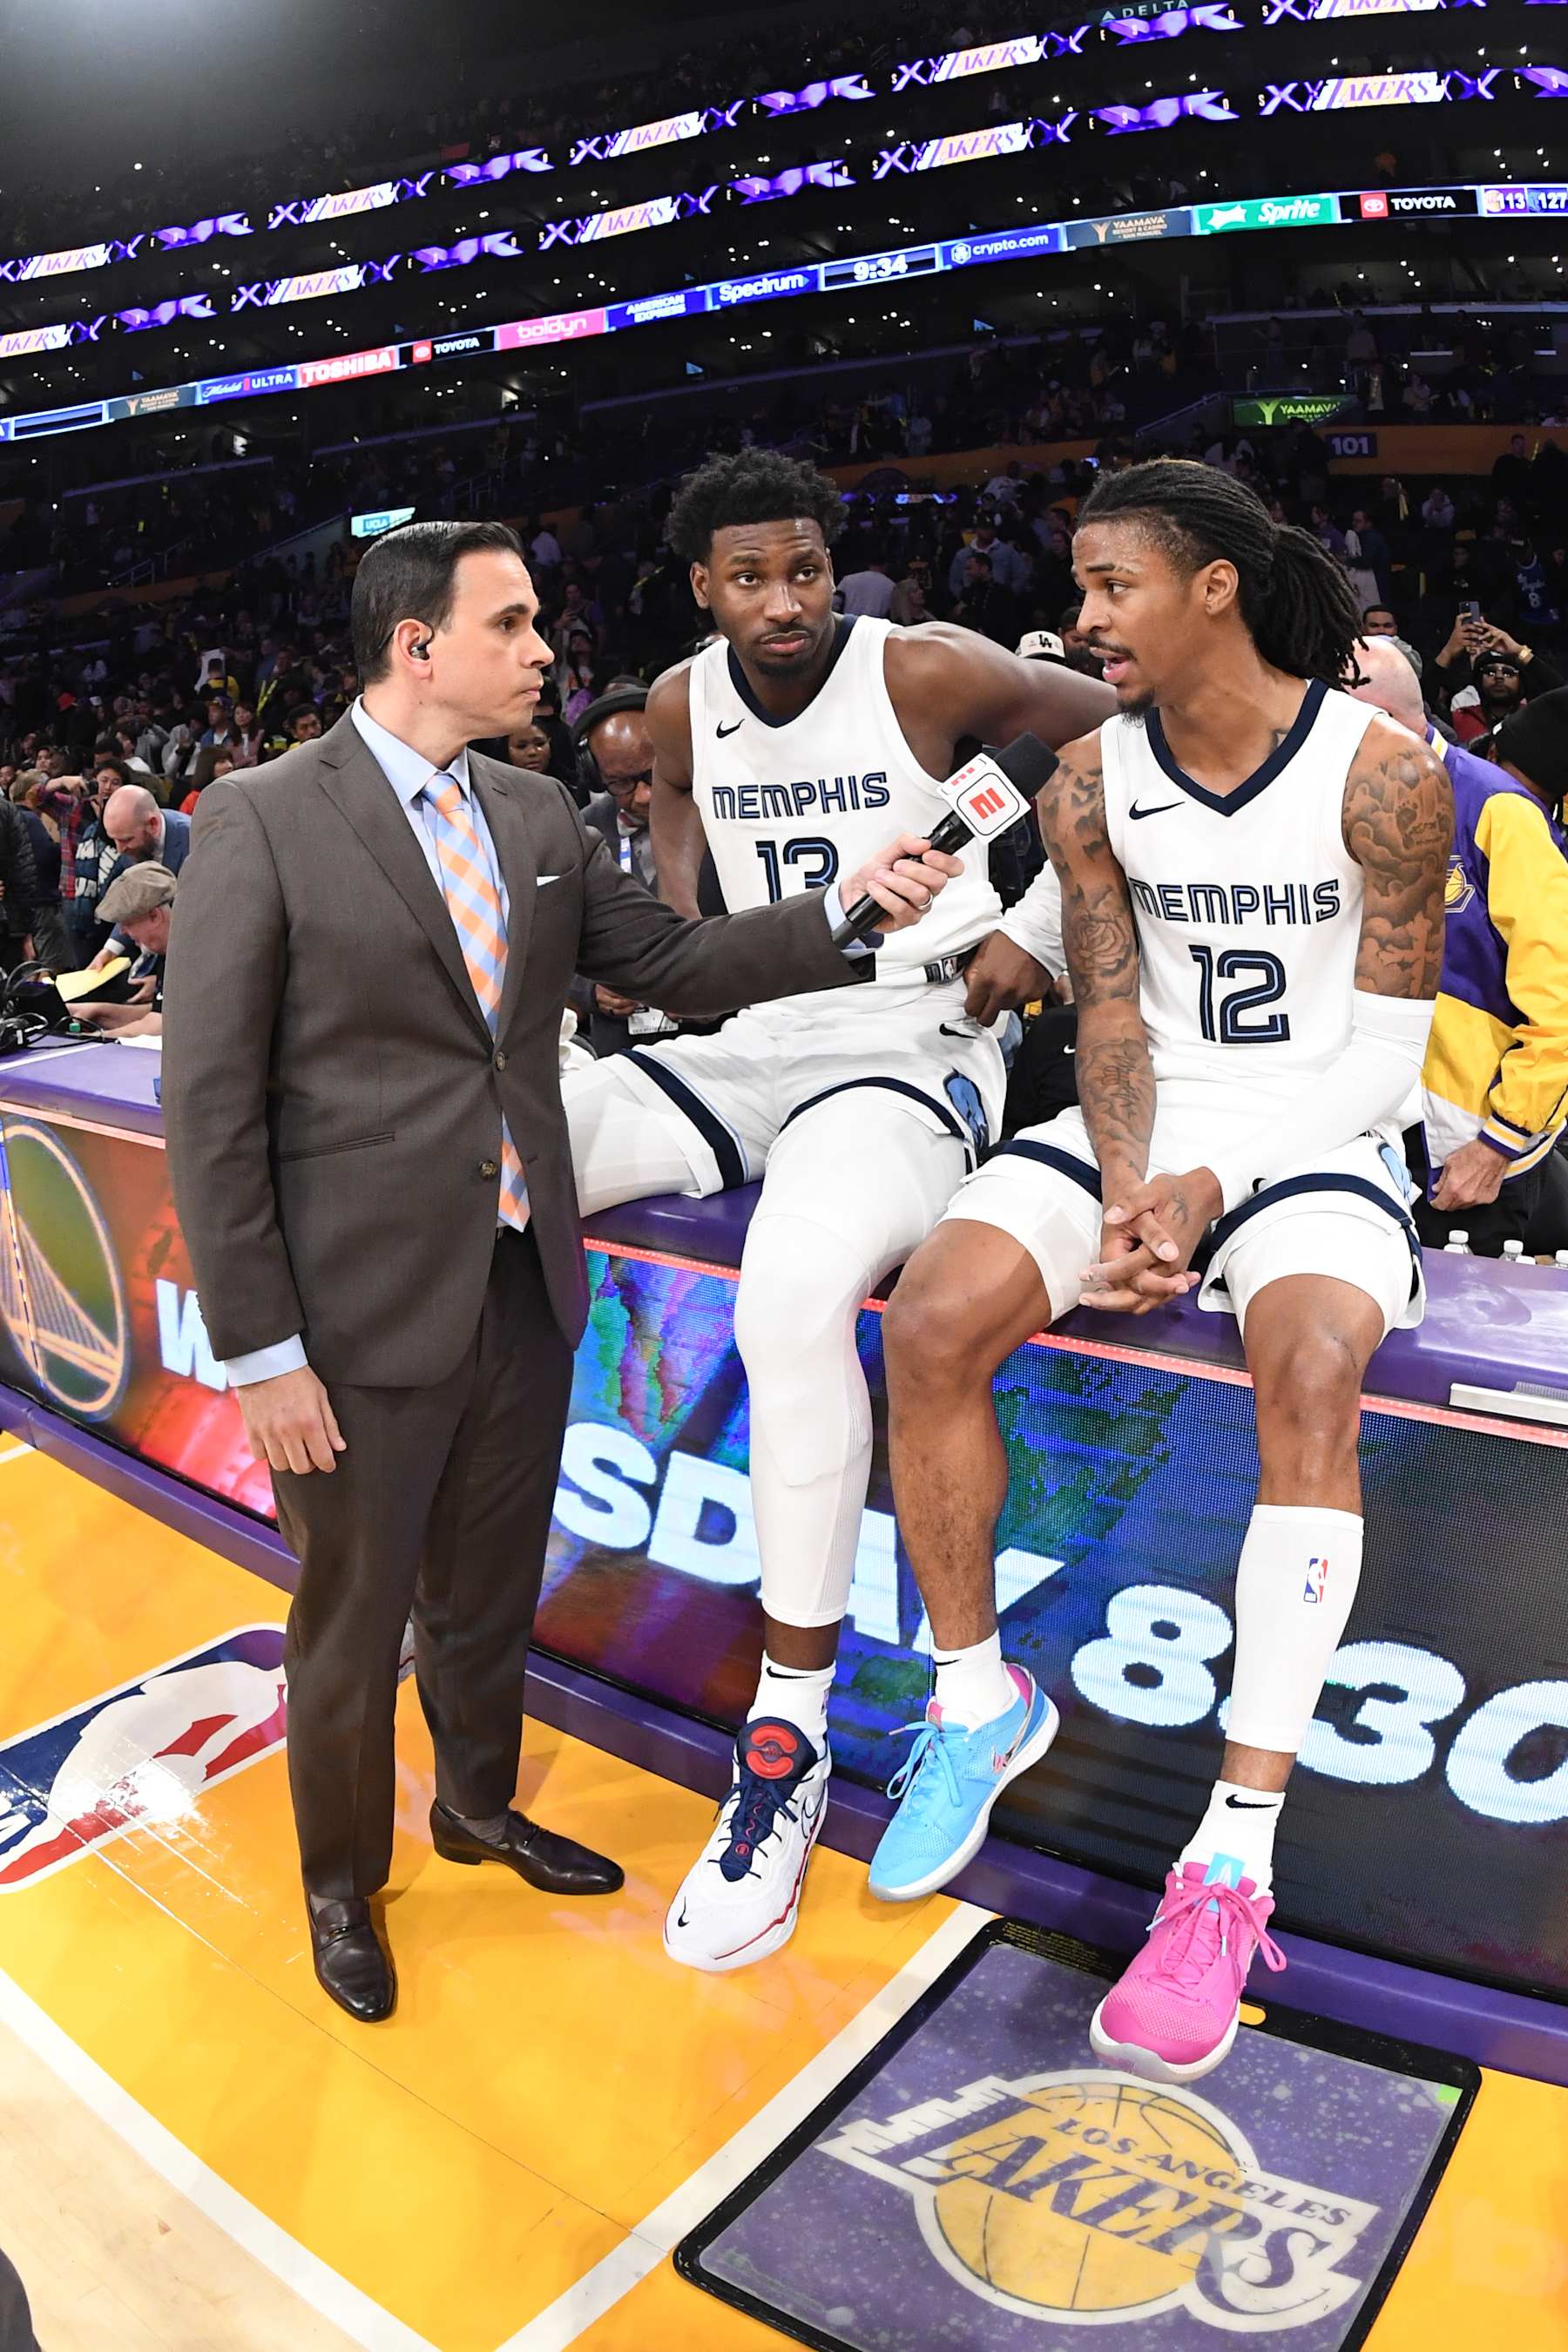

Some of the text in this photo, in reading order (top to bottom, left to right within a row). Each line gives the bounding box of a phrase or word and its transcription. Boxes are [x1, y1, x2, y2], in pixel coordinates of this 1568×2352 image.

[1122, 0, 1188, 18] DELTA
[1257, 199, 1320, 225] Sprite
[1391, 195, 1456, 211] TOYOTA
[1497, 193, 1525, 210] 113
[1538, 193, 1568, 210] 127
[973, 233, 1049, 255] crypto.com
[853, 254, 909, 281] 9:34
[720, 274, 805, 304] Spectrum
[626, 294, 685, 315] AMERICAN
[634, 303, 686, 323] EXPRESS
[517, 318, 586, 338] boldyn
[434, 337, 480, 355] TOYOTA
[303, 351, 392, 383] TOSHIBA
[252, 373, 294, 389] ULTRA
[1332, 436, 1369, 455] 101
[1038, 633, 1052, 648] LA
[712, 772, 890, 820] MEMPHIS
[1129, 878, 1340, 925] MEMPHIS
[1189, 944, 1290, 1044] 12
[1053, 2117, 1352, 2227] LOS ANGELES
[858, 2092, 1332, 2315] LAKERS
